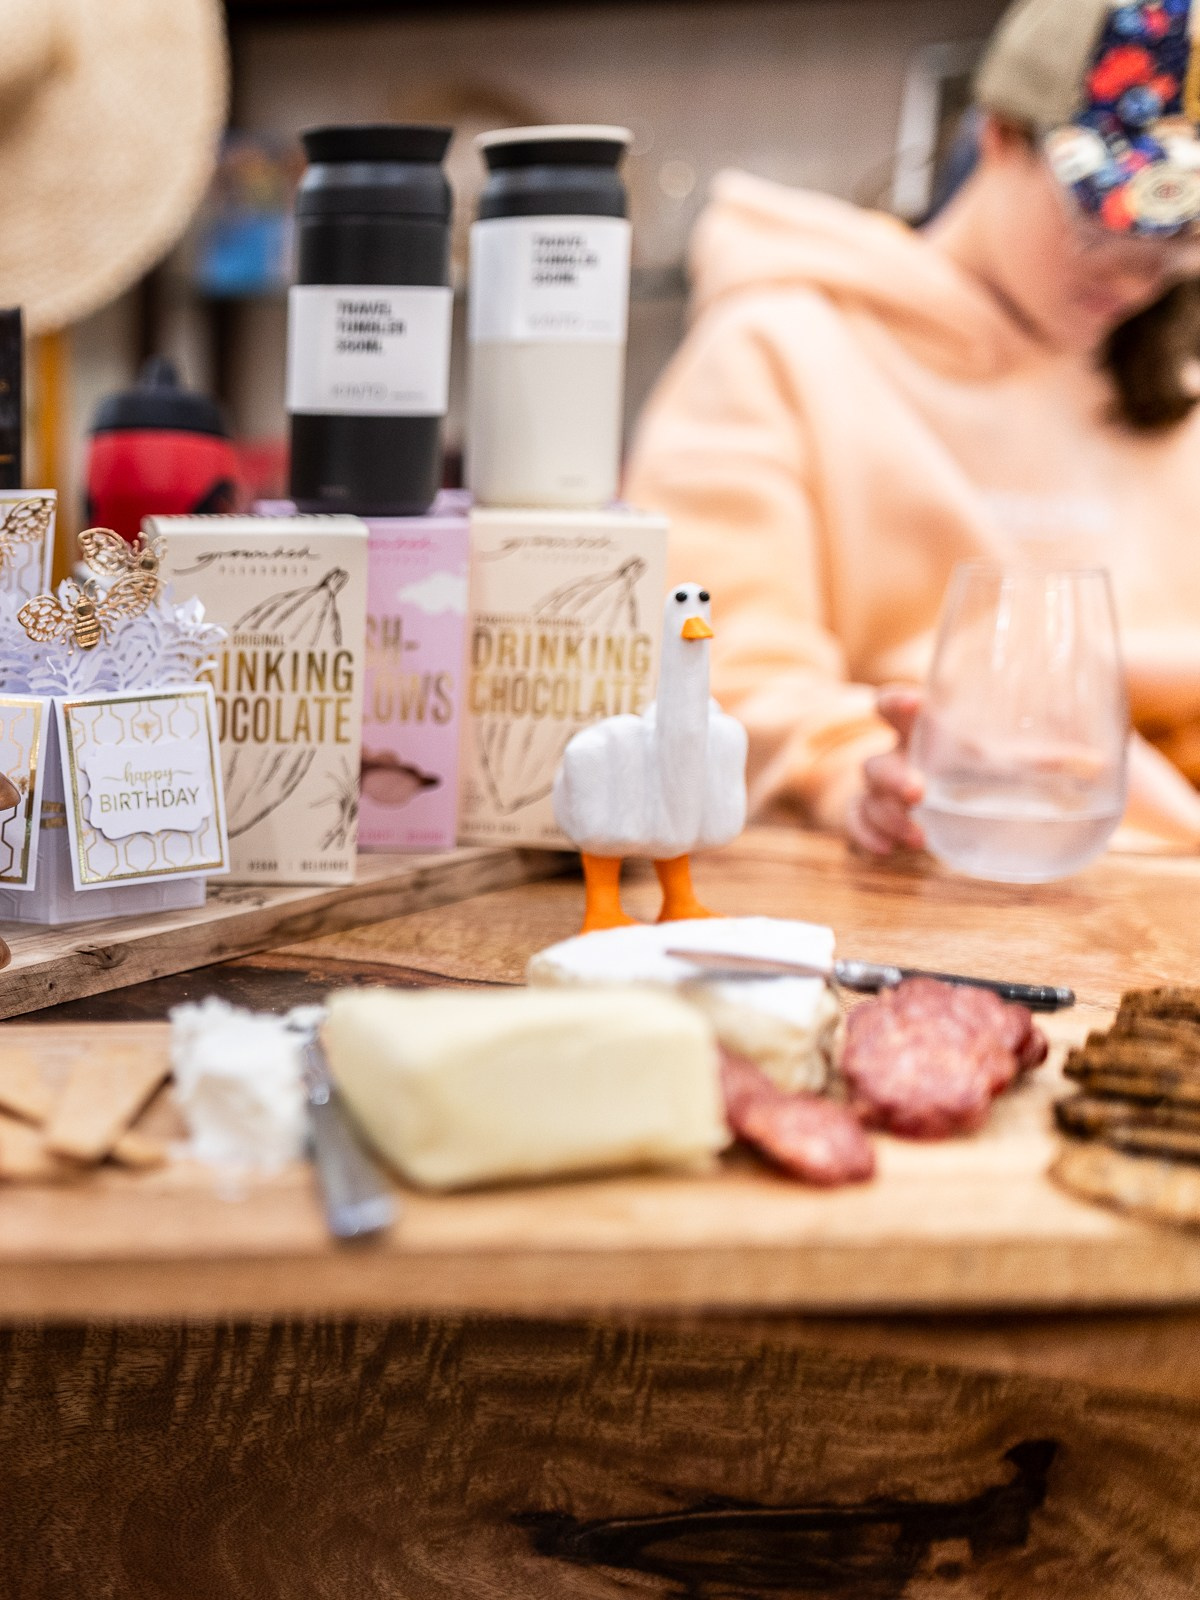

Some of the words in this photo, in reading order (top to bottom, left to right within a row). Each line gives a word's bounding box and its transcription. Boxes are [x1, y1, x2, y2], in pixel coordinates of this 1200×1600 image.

[232, 633, 285, 647] ORIGINAL
[472, 624, 651, 675] DRINKING
[196, 650, 355, 692] INKING
[468, 671, 647, 720] CHOCOLATE
[215, 696, 351, 744] OCOLATE
[100, 787, 200, 813] BIRTHDAY
